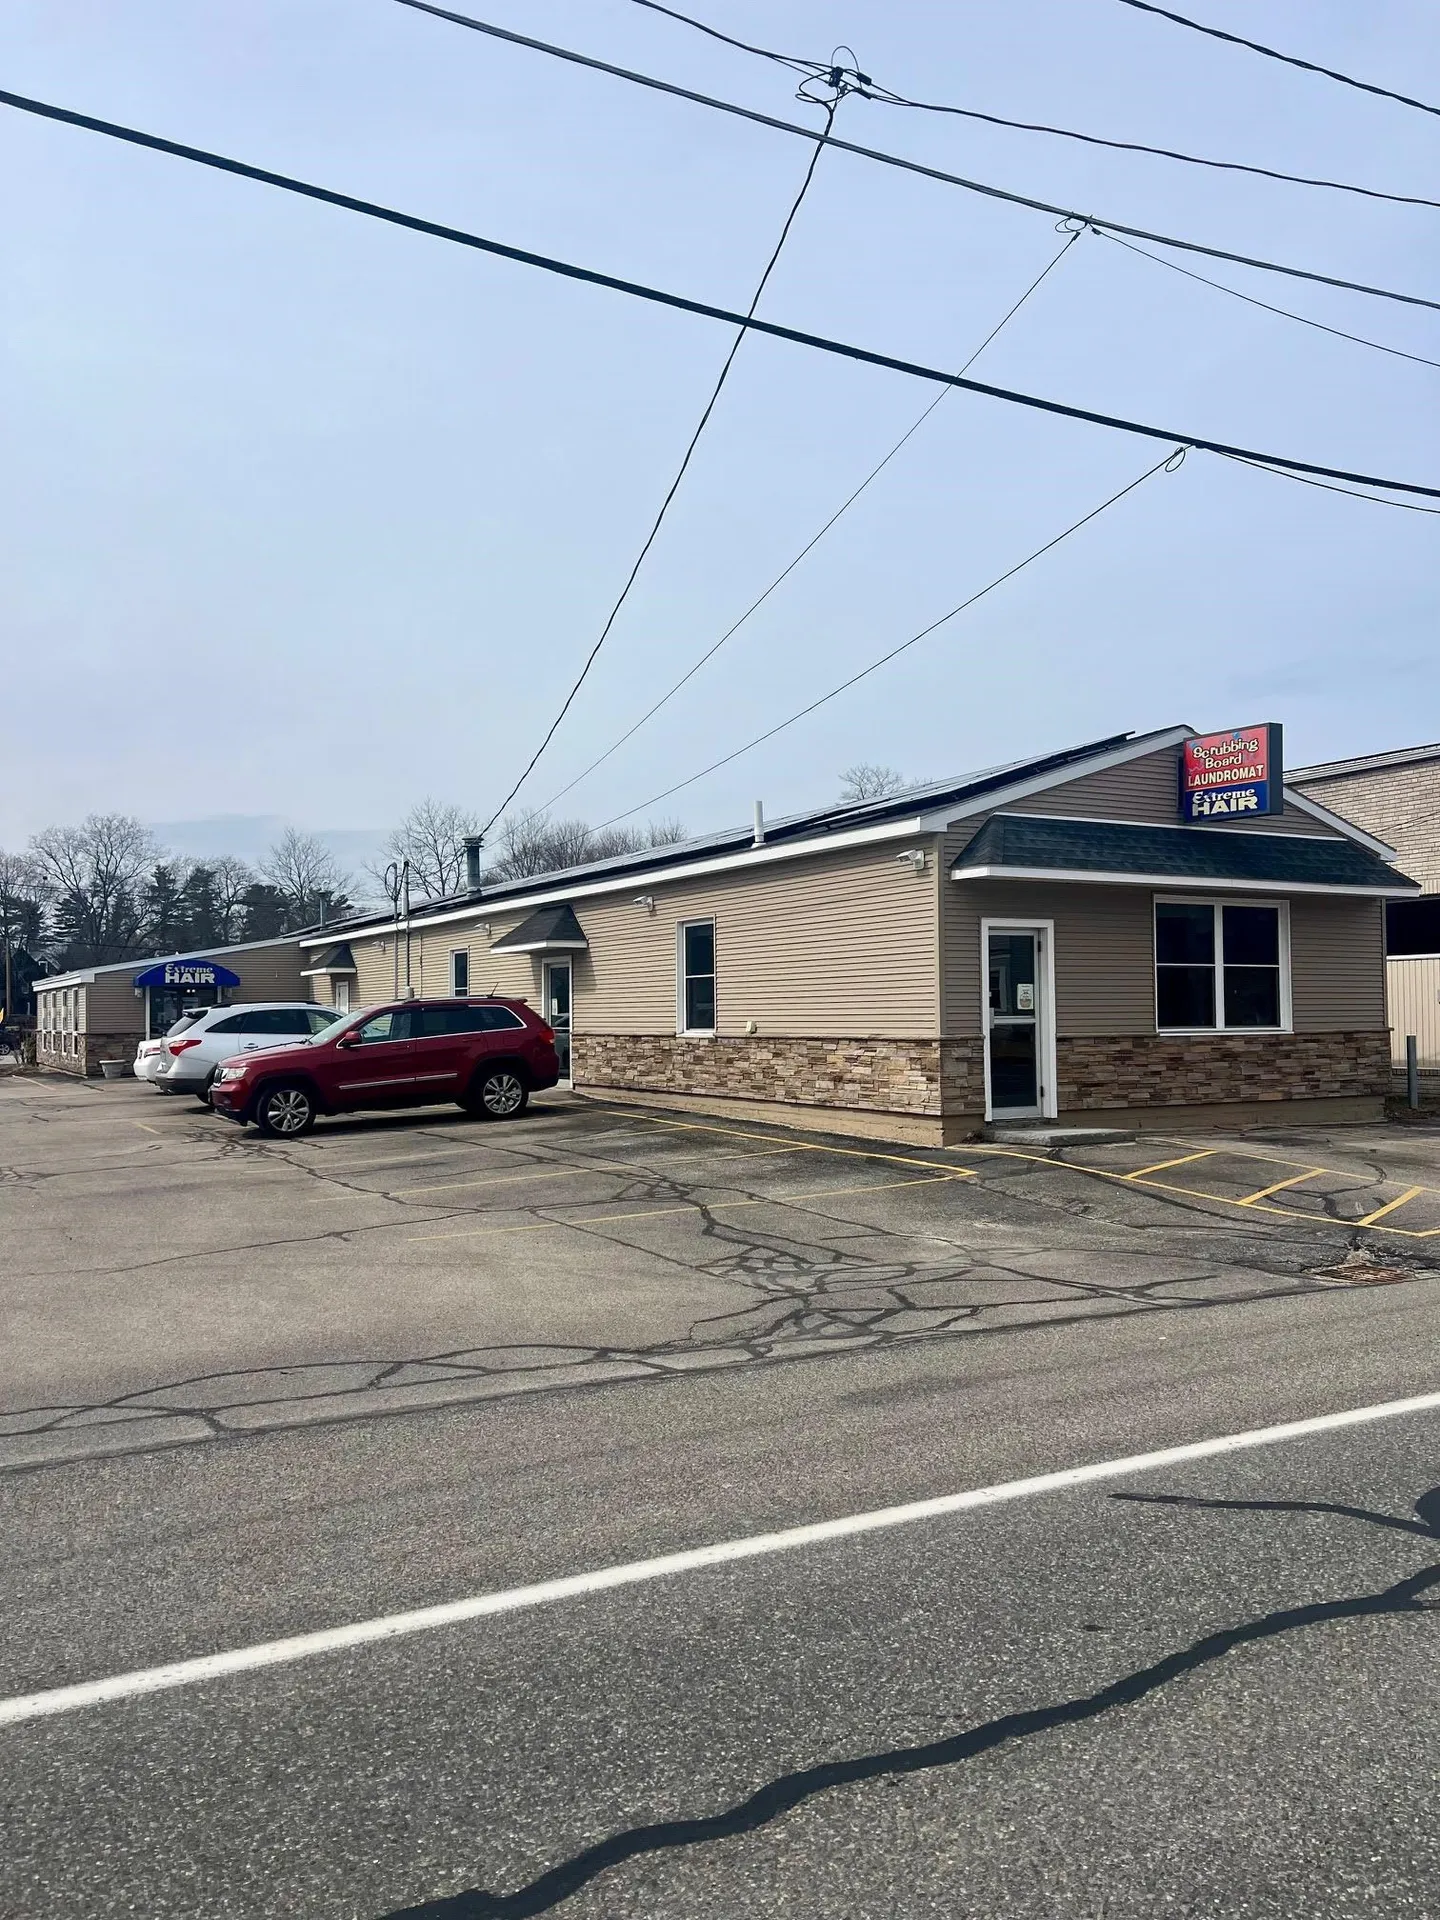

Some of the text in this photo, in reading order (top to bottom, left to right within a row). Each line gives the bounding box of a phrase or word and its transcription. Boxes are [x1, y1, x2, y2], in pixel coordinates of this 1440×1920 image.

[1193, 738, 1259, 758] Scrubbing
[1205, 752, 1242, 769] Board
[1188, 764, 1264, 786] LAUNDROMAT
[1193, 788, 1255, 804] Extreme
[1192, 796, 1258, 817] HAIR
[165, 963, 213, 974] Extreme
[165, 972, 215, 984] HAIR
